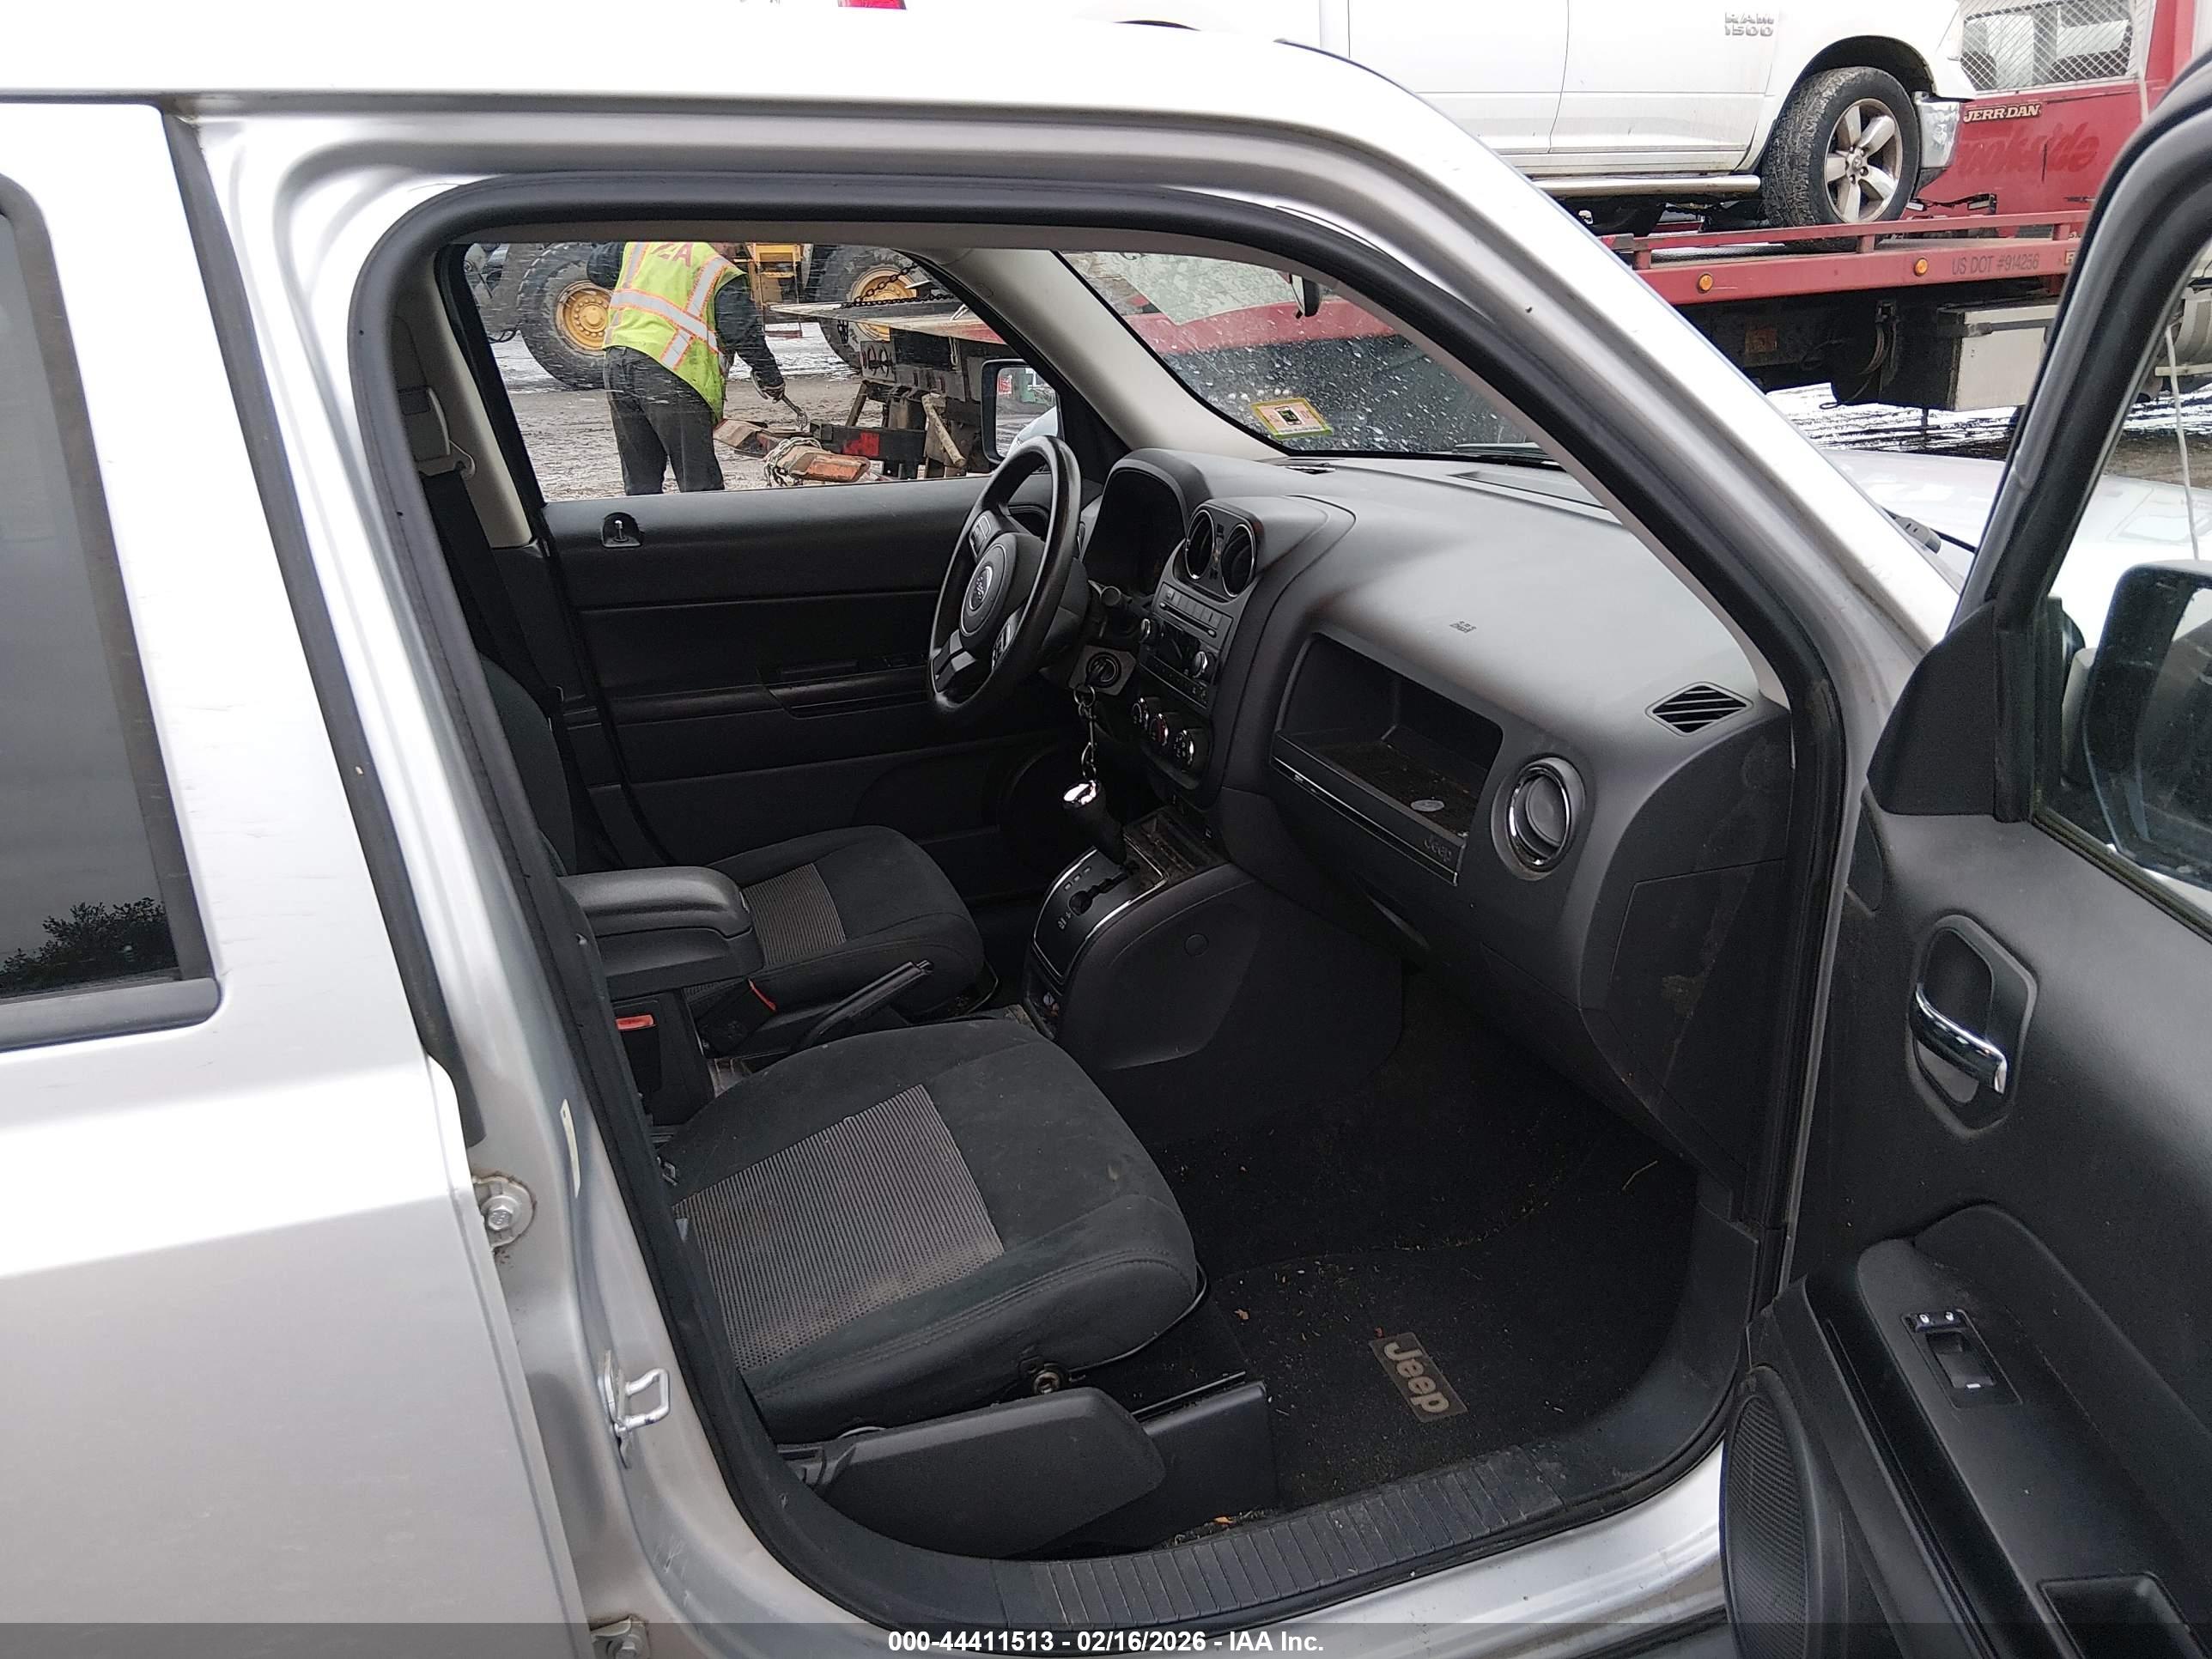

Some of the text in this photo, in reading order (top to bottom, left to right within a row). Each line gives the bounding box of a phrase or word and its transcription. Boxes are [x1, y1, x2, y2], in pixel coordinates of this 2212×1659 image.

[1724, 11, 1775, 24] RAM
[1724, 24, 1775, 36] 1500
[1952, 252, 2040, 275] US DOT #914256
[1383, 1341, 1449, 1413] Jeep
